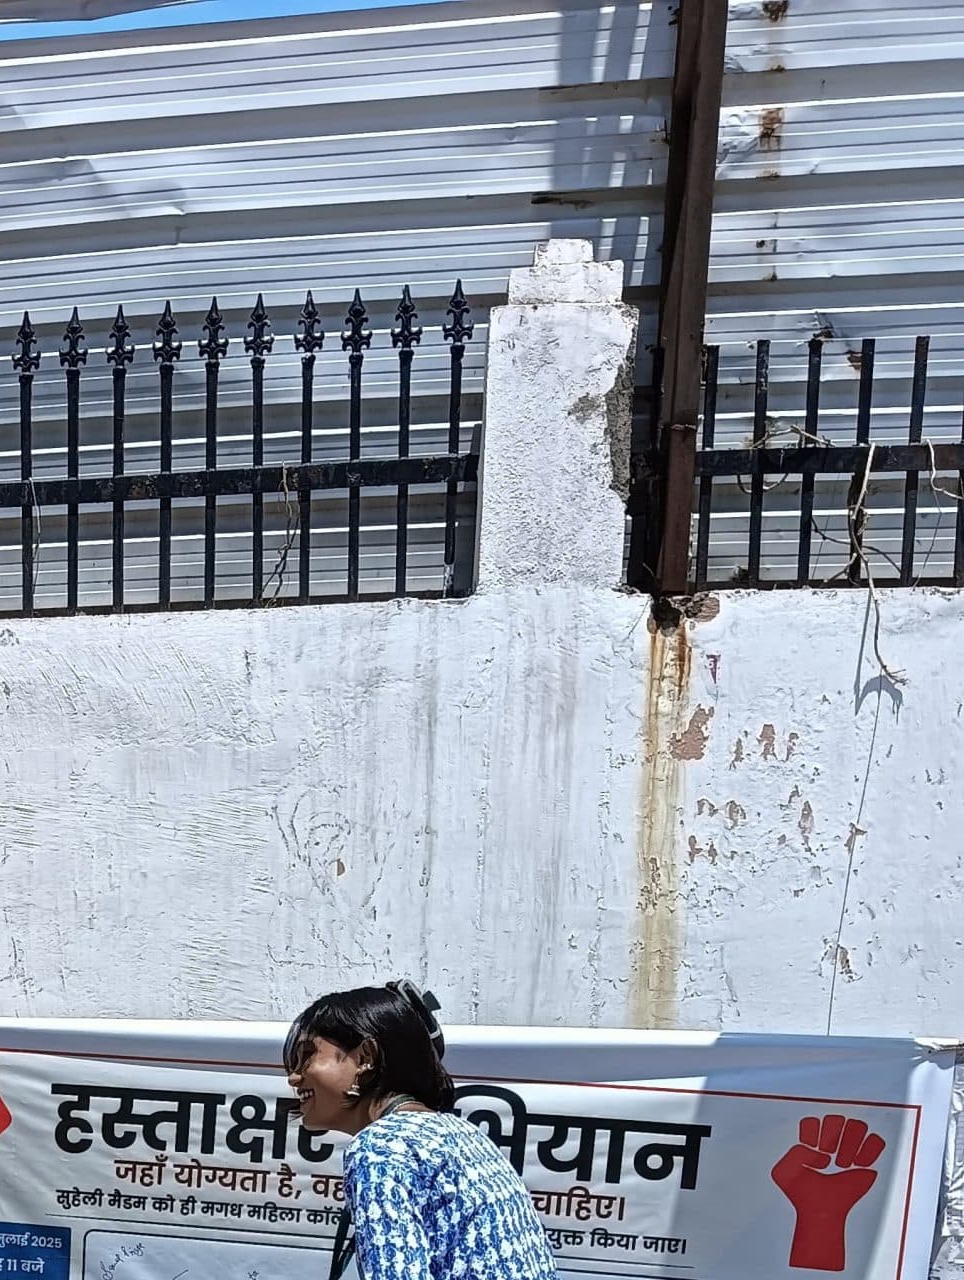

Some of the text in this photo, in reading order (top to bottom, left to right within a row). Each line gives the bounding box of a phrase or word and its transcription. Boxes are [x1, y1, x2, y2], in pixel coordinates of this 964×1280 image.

[51, 1083, 712, 1191] हस्ताक्षर भियान
[114, 1154, 168, 1187] जहाँ
[173, 1158, 270, 1193] योग्यता
[277, 1163, 302, 1199] है,
[31, 1237, 62, 1249] 2025
[56, 1187, 104, 1210] सुहेली
[108, 1189, 148, 1211] मैडम
[151, 1194, 175, 1213] को
[179, 1196, 197, 1216] ही
[201, 1201, 244, 1218] मगध
[247, 1202, 302, 1223] महिला
[590, 1227, 638, 1251] किया
[643, 1236, 687, 1254] जाए।
[7, 1259, 18, 1271] 11
[21, 1257, 45, 1274] बजे
